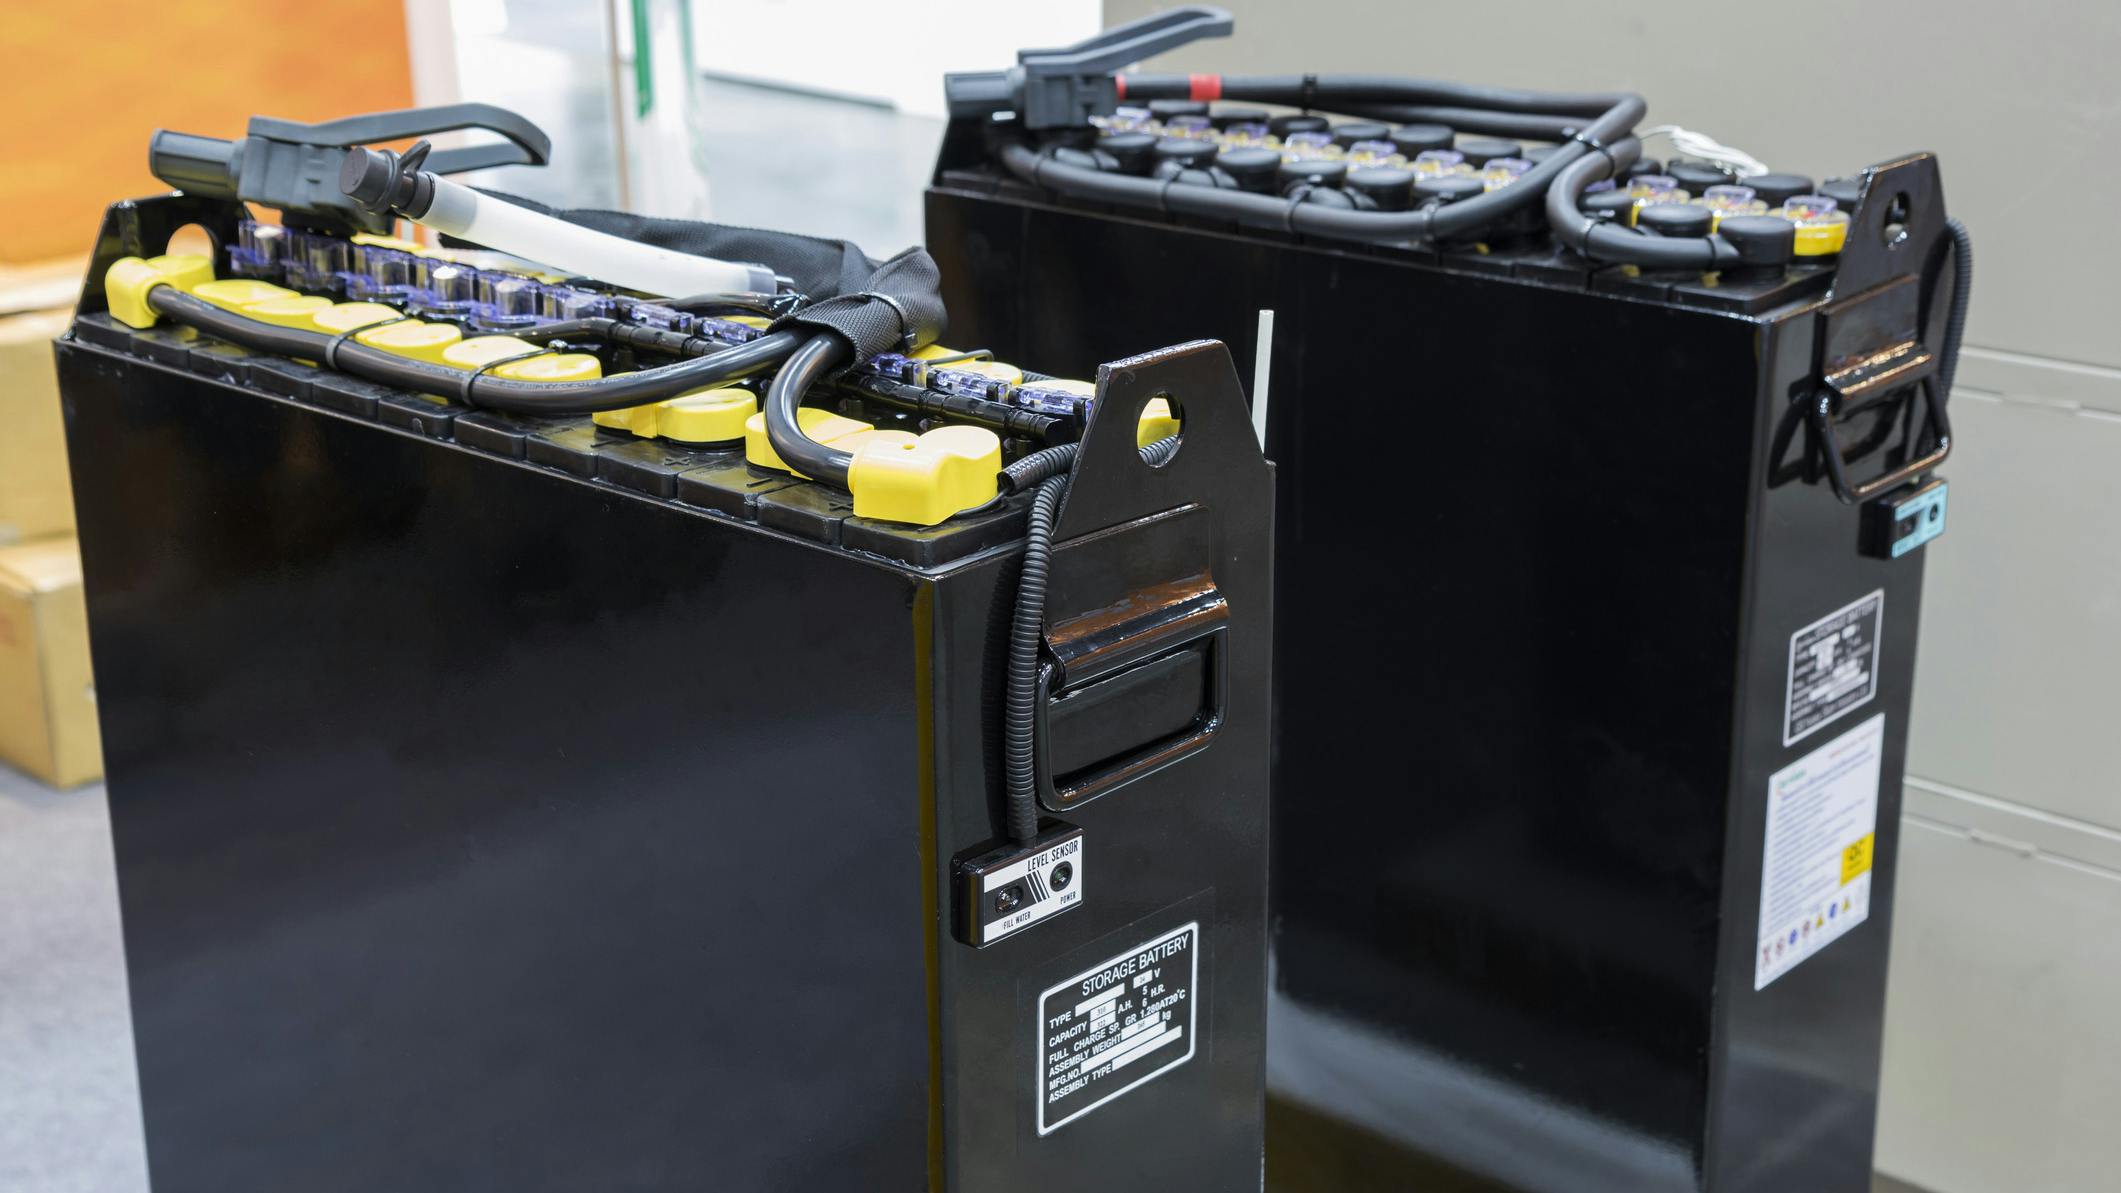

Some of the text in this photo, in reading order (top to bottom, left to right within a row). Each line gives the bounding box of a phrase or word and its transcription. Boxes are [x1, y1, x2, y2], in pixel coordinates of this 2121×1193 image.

[1028, 840, 1078, 871] LEVEL SENSOR
[1060, 891, 1076, 904] POWER
[1003, 911, 1031, 929] FILL WATER
[1082, 933, 1189, 996] STORAGE BATTERY
[1049, 1011, 1071, 1029] TYPE
[1154, 967, 1160, 978] V
[1049, 1021, 1087, 1047] CAPACITY
[1142, 985, 1148, 995] 5
[1142, 998, 1147, 1007] 6
[1049, 1048, 1069, 1064] FULL
[1073, 1028, 1106, 1052] CHARGE
[1109, 1022, 1120, 1035] SP.
[1049, 1050, 1089, 1077] ASSEMBLY
[1093, 1034, 1121, 1055] WEIGHT
[1049, 1064, 1112, 1104] ASSEMBLY TYPE
